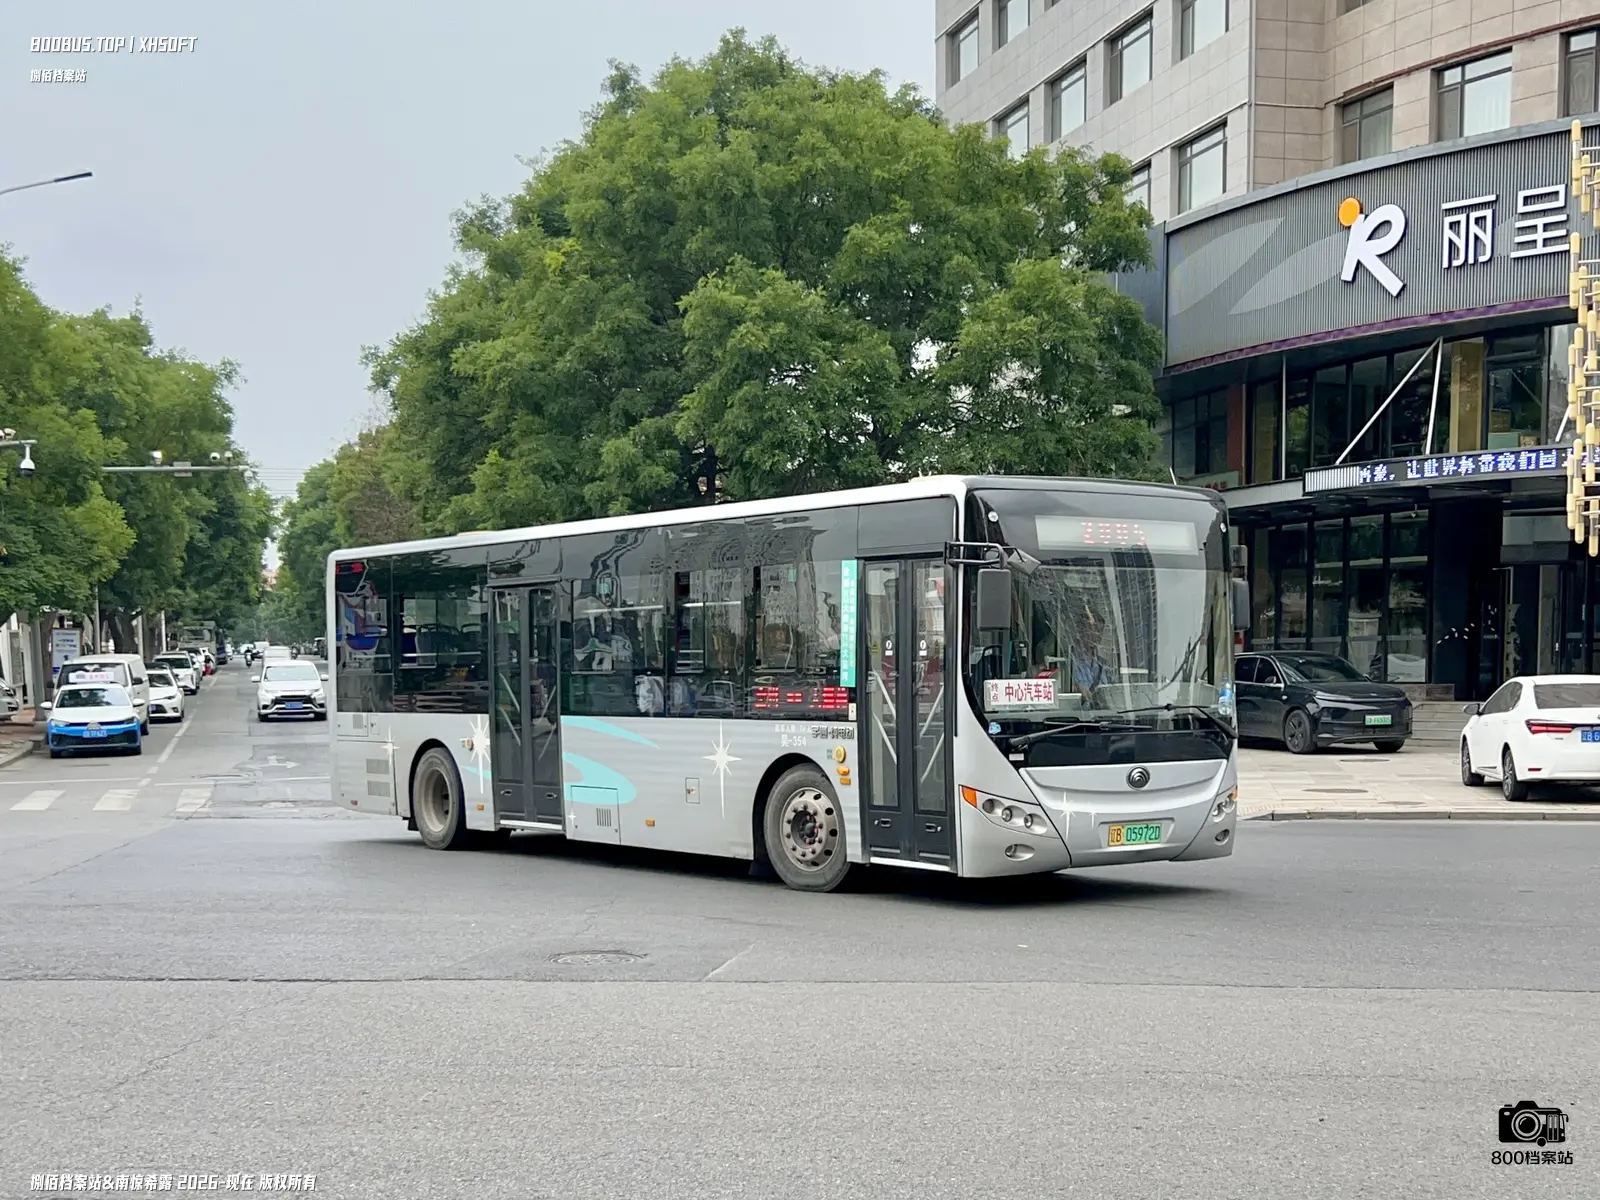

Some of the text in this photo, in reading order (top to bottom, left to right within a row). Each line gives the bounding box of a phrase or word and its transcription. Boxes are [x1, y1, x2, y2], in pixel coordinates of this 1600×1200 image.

[1441, 183, 1570, 268] 丽呈
[1005, 682, 1052, 702] 中心汽车站
